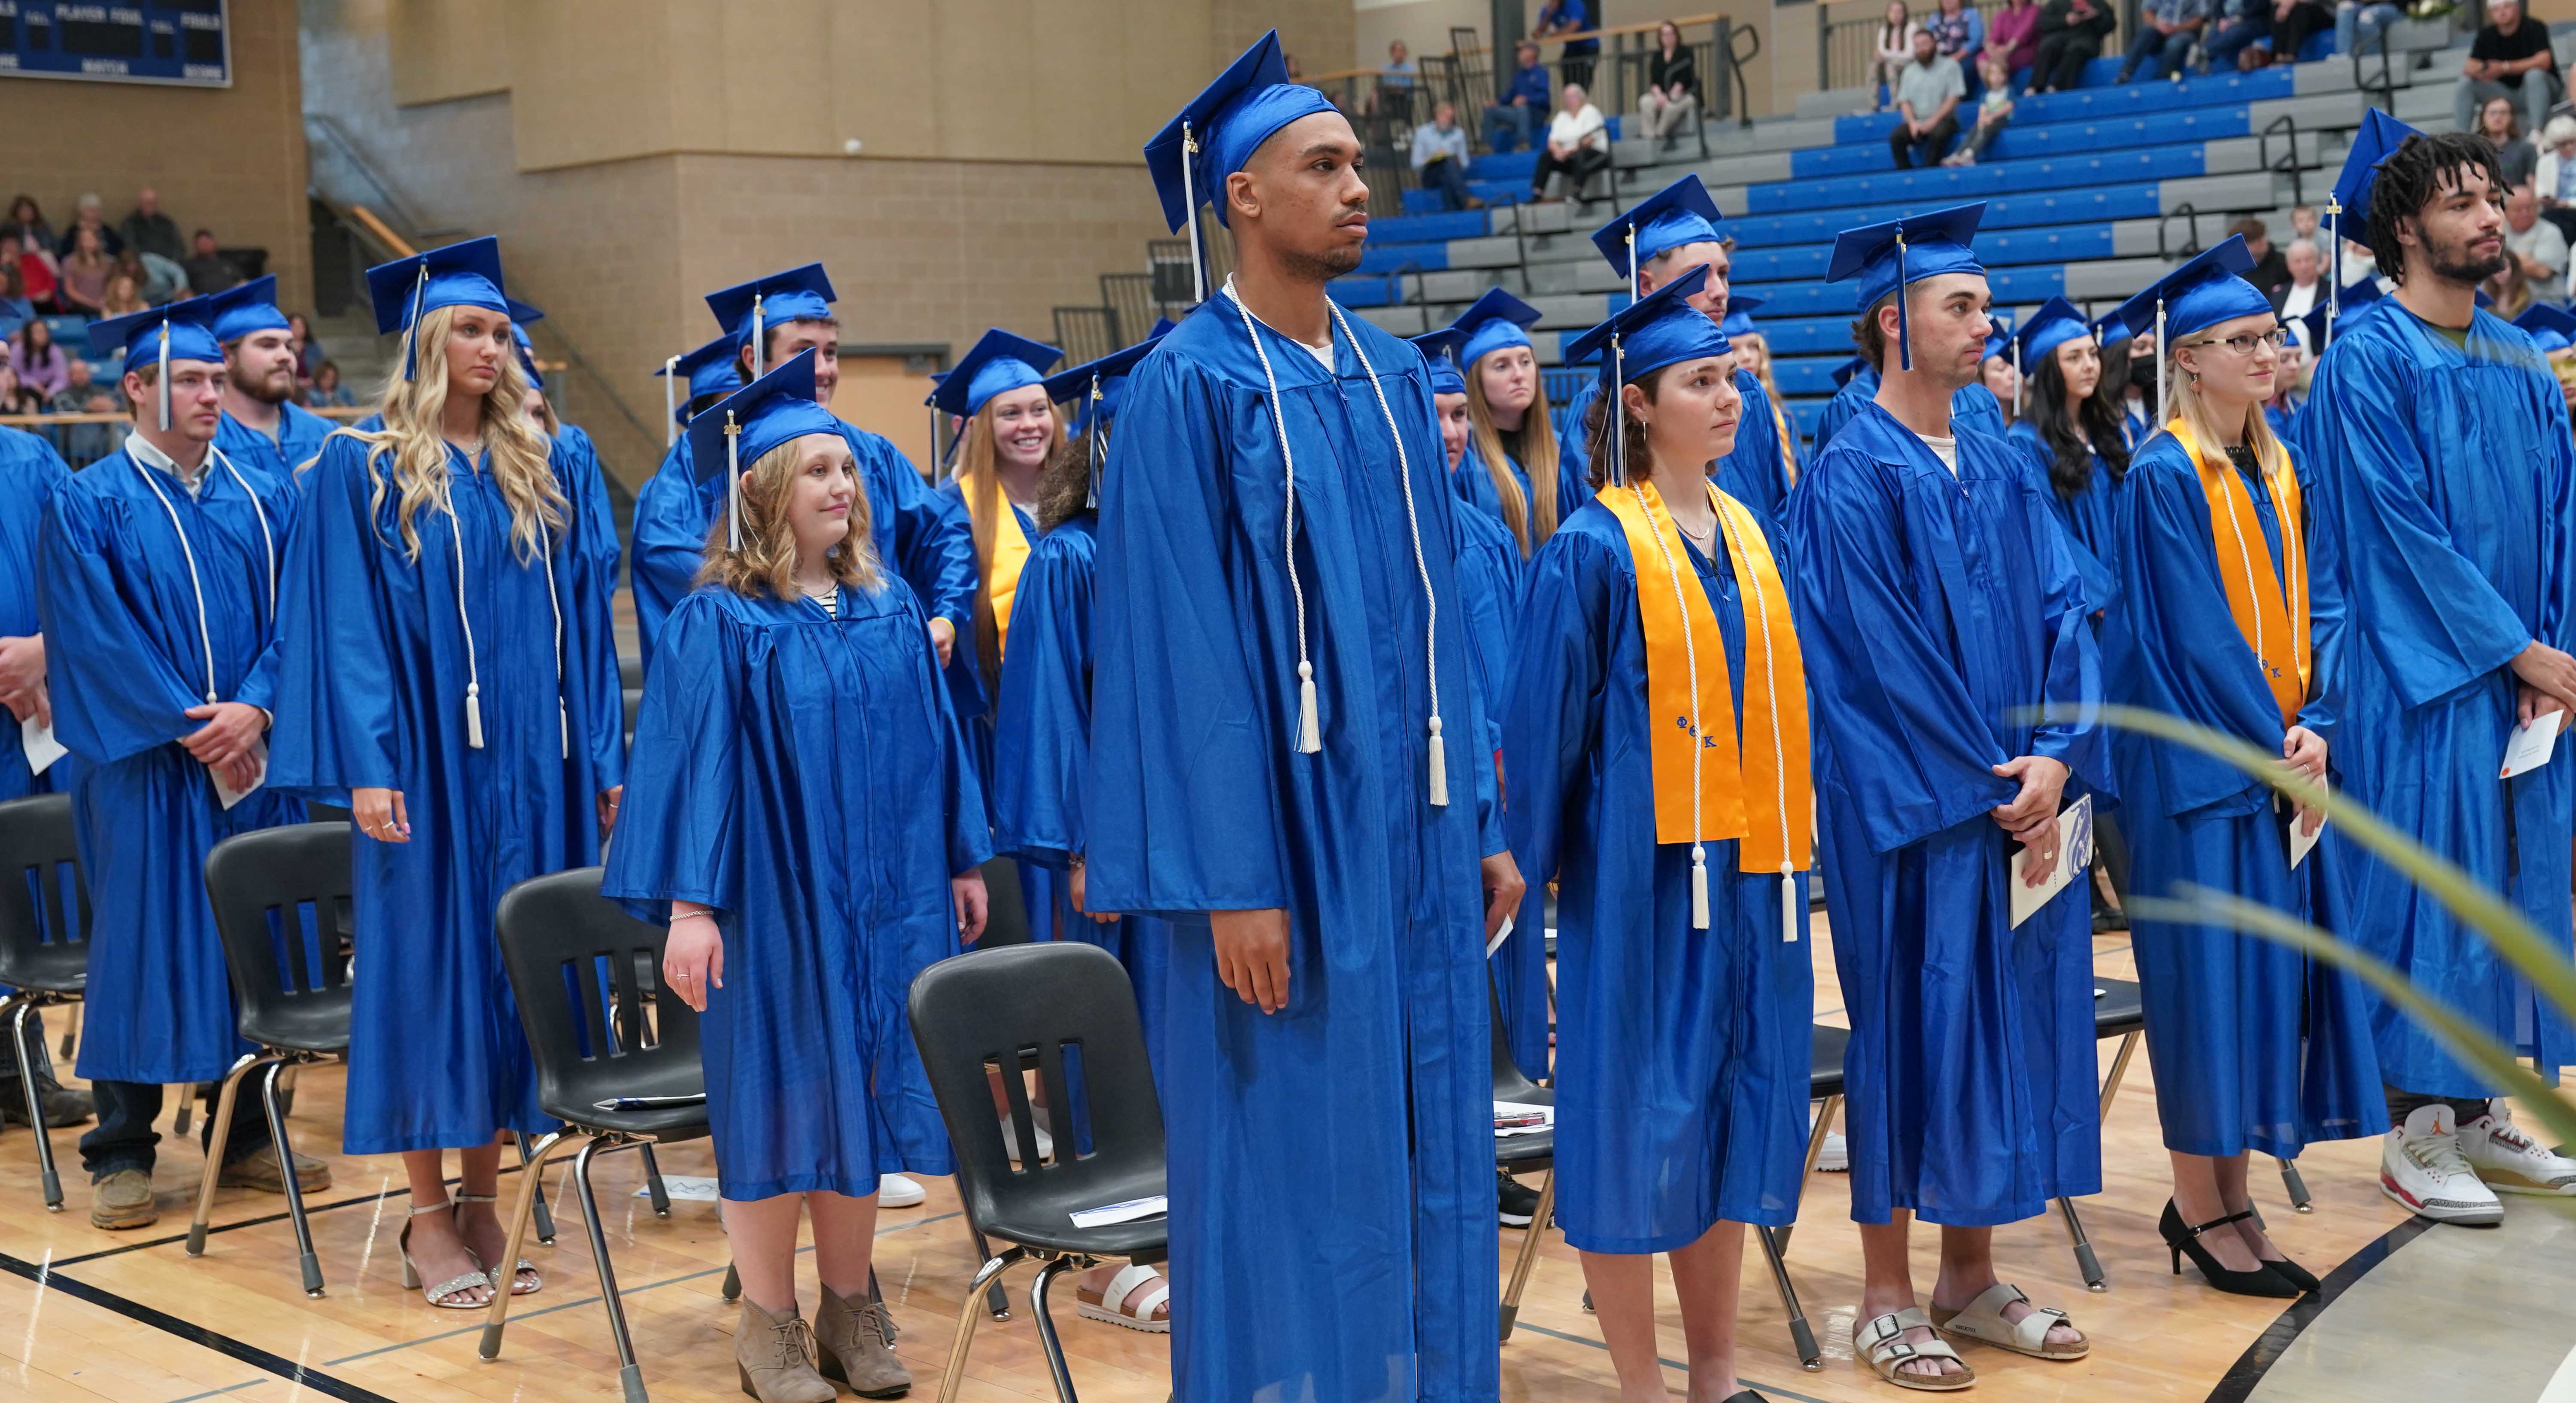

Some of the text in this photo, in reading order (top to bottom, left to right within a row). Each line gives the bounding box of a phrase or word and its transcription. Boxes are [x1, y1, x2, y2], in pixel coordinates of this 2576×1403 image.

[55, 3, 143, 25] PLAYER FOUL
[180, 12, 221, 30] FOULS
[82, 58, 128, 74] MATCH
[183, 64, 222, 79] SCORE
